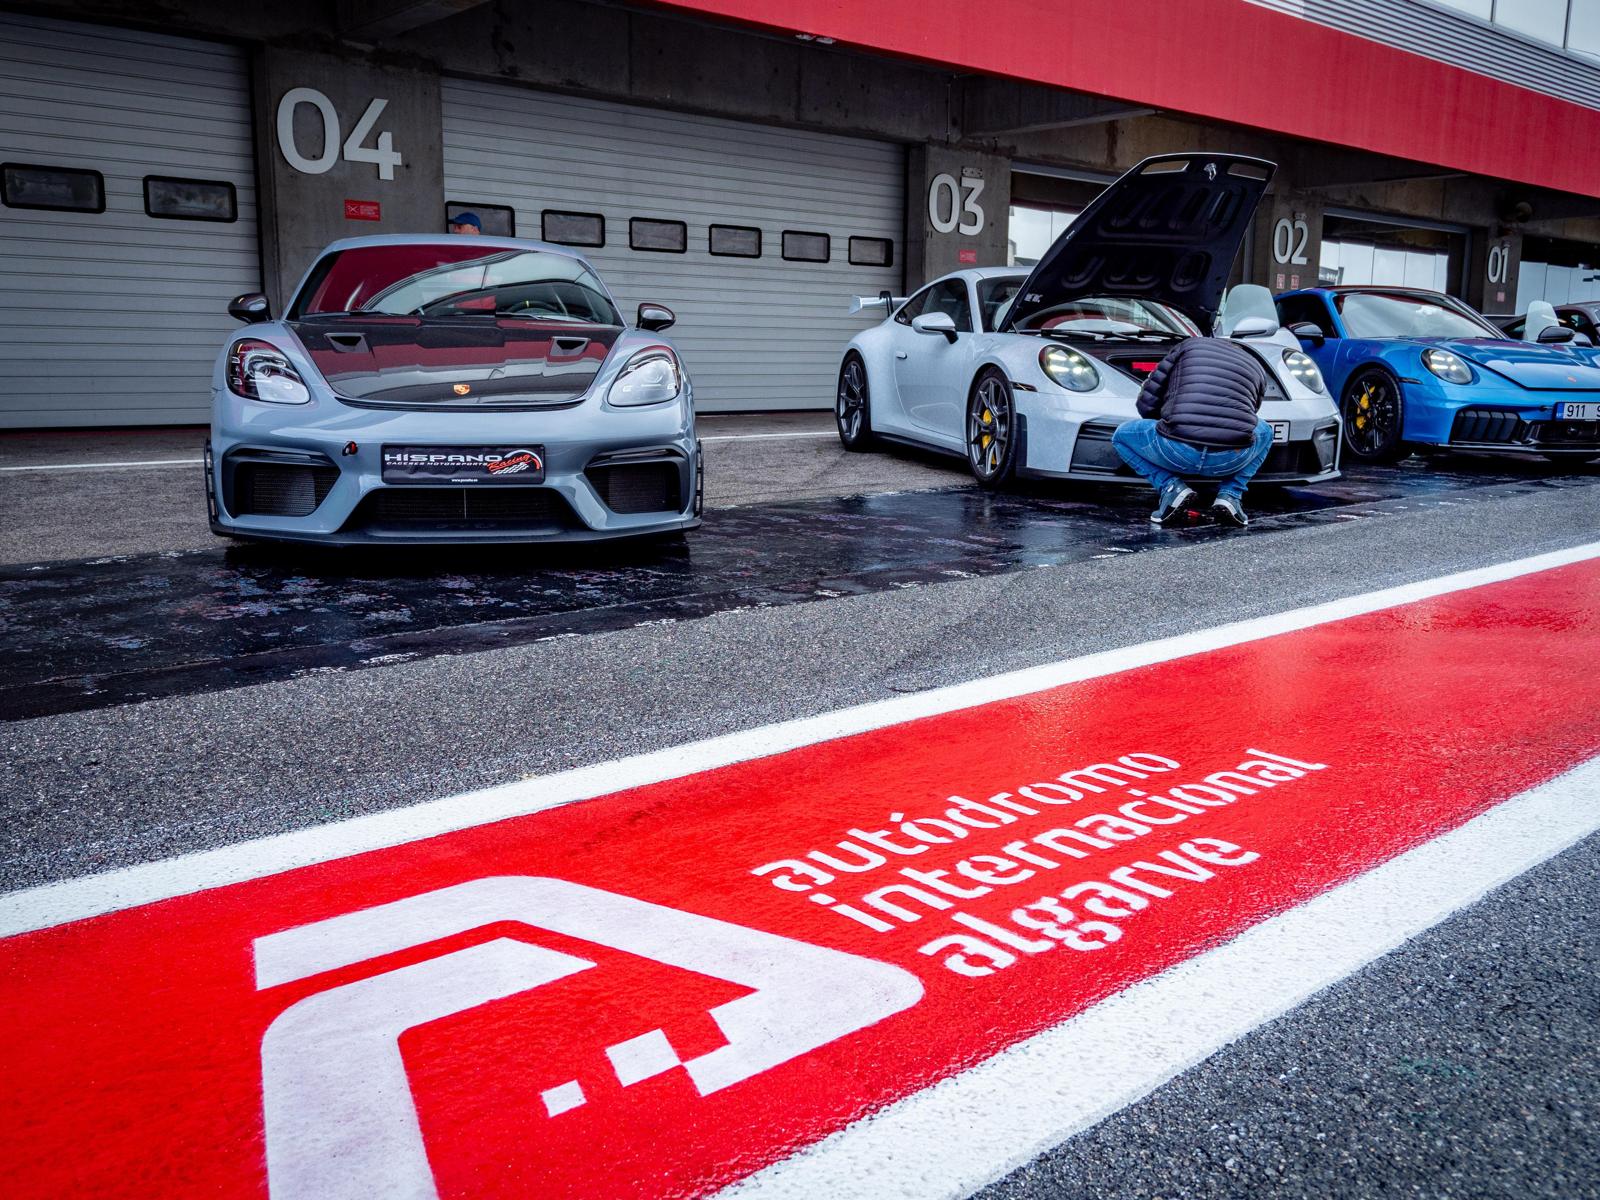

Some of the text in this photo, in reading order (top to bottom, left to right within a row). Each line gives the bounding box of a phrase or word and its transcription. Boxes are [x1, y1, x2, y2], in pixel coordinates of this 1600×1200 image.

[276, 87, 402, 180] 04
[929, 173, 984, 235] 03
[1273, 218, 1308, 264] 02
[1488, 246, 1509, 284] 01
[1270, 424, 1284, 440] E
[1567, 404, 1585, 418] 911
[751, 752, 1181, 892] autódromo
[808, 748, 1329, 932] internacional
[918, 837, 1262, 976] algarve
